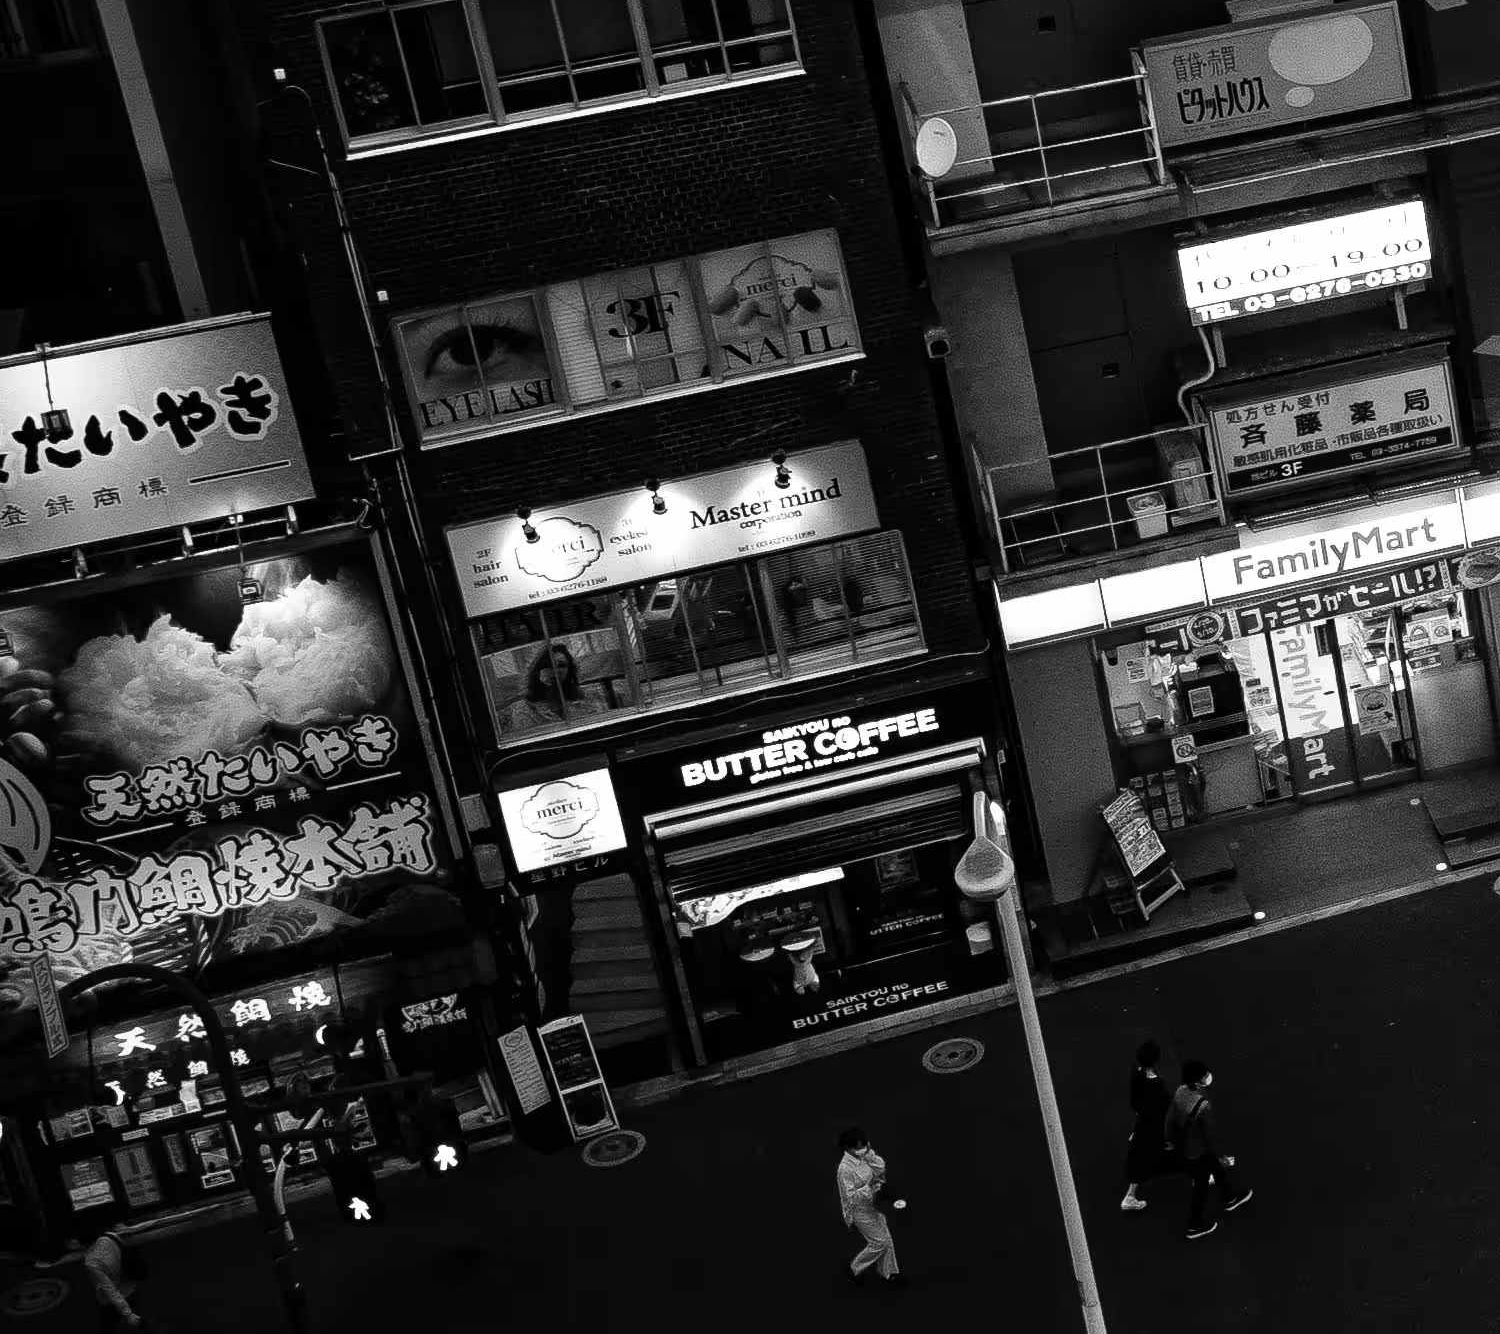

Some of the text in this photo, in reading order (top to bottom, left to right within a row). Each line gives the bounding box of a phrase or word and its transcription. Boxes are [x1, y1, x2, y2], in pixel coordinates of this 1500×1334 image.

[1174, 45, 1238, 84] 賃貸・売買
[1176, 76, 1270, 124] ピタットハウス
[746, 274, 797, 297] merci
[606, 290, 680, 340] 3F
[1195, 302, 1240, 322] TEL
[722, 325, 848, 369] NAIL
[0, 373, 274, 483] たいやき
[1225, 391, 1331, 424] 処方せん受付
[1240, 388, 1430, 449] 斉藤薬局
[1281, 462, 1303, 477] 3F
[690, 478, 842, 530] Master mind
[473, 559, 502, 575] hair
[1233, 517, 1438, 586] FamilyMart
[473, 574, 509, 589] salon
[680, 708, 940, 788] BUTTER COFFEE
[762, 718, 830, 744] SAIKYOU
[83, 715, 398, 825] 天然たいやき
[184, 786, 312, 827] 登録商標
[536, 796, 583, 820] merci
[0, 793, 434, 954] 鳴門鯛焼本舗
[114, 980, 332, 1057] 天然鯛焼
[792, 979, 949, 1030] BUTTER COFFEE
